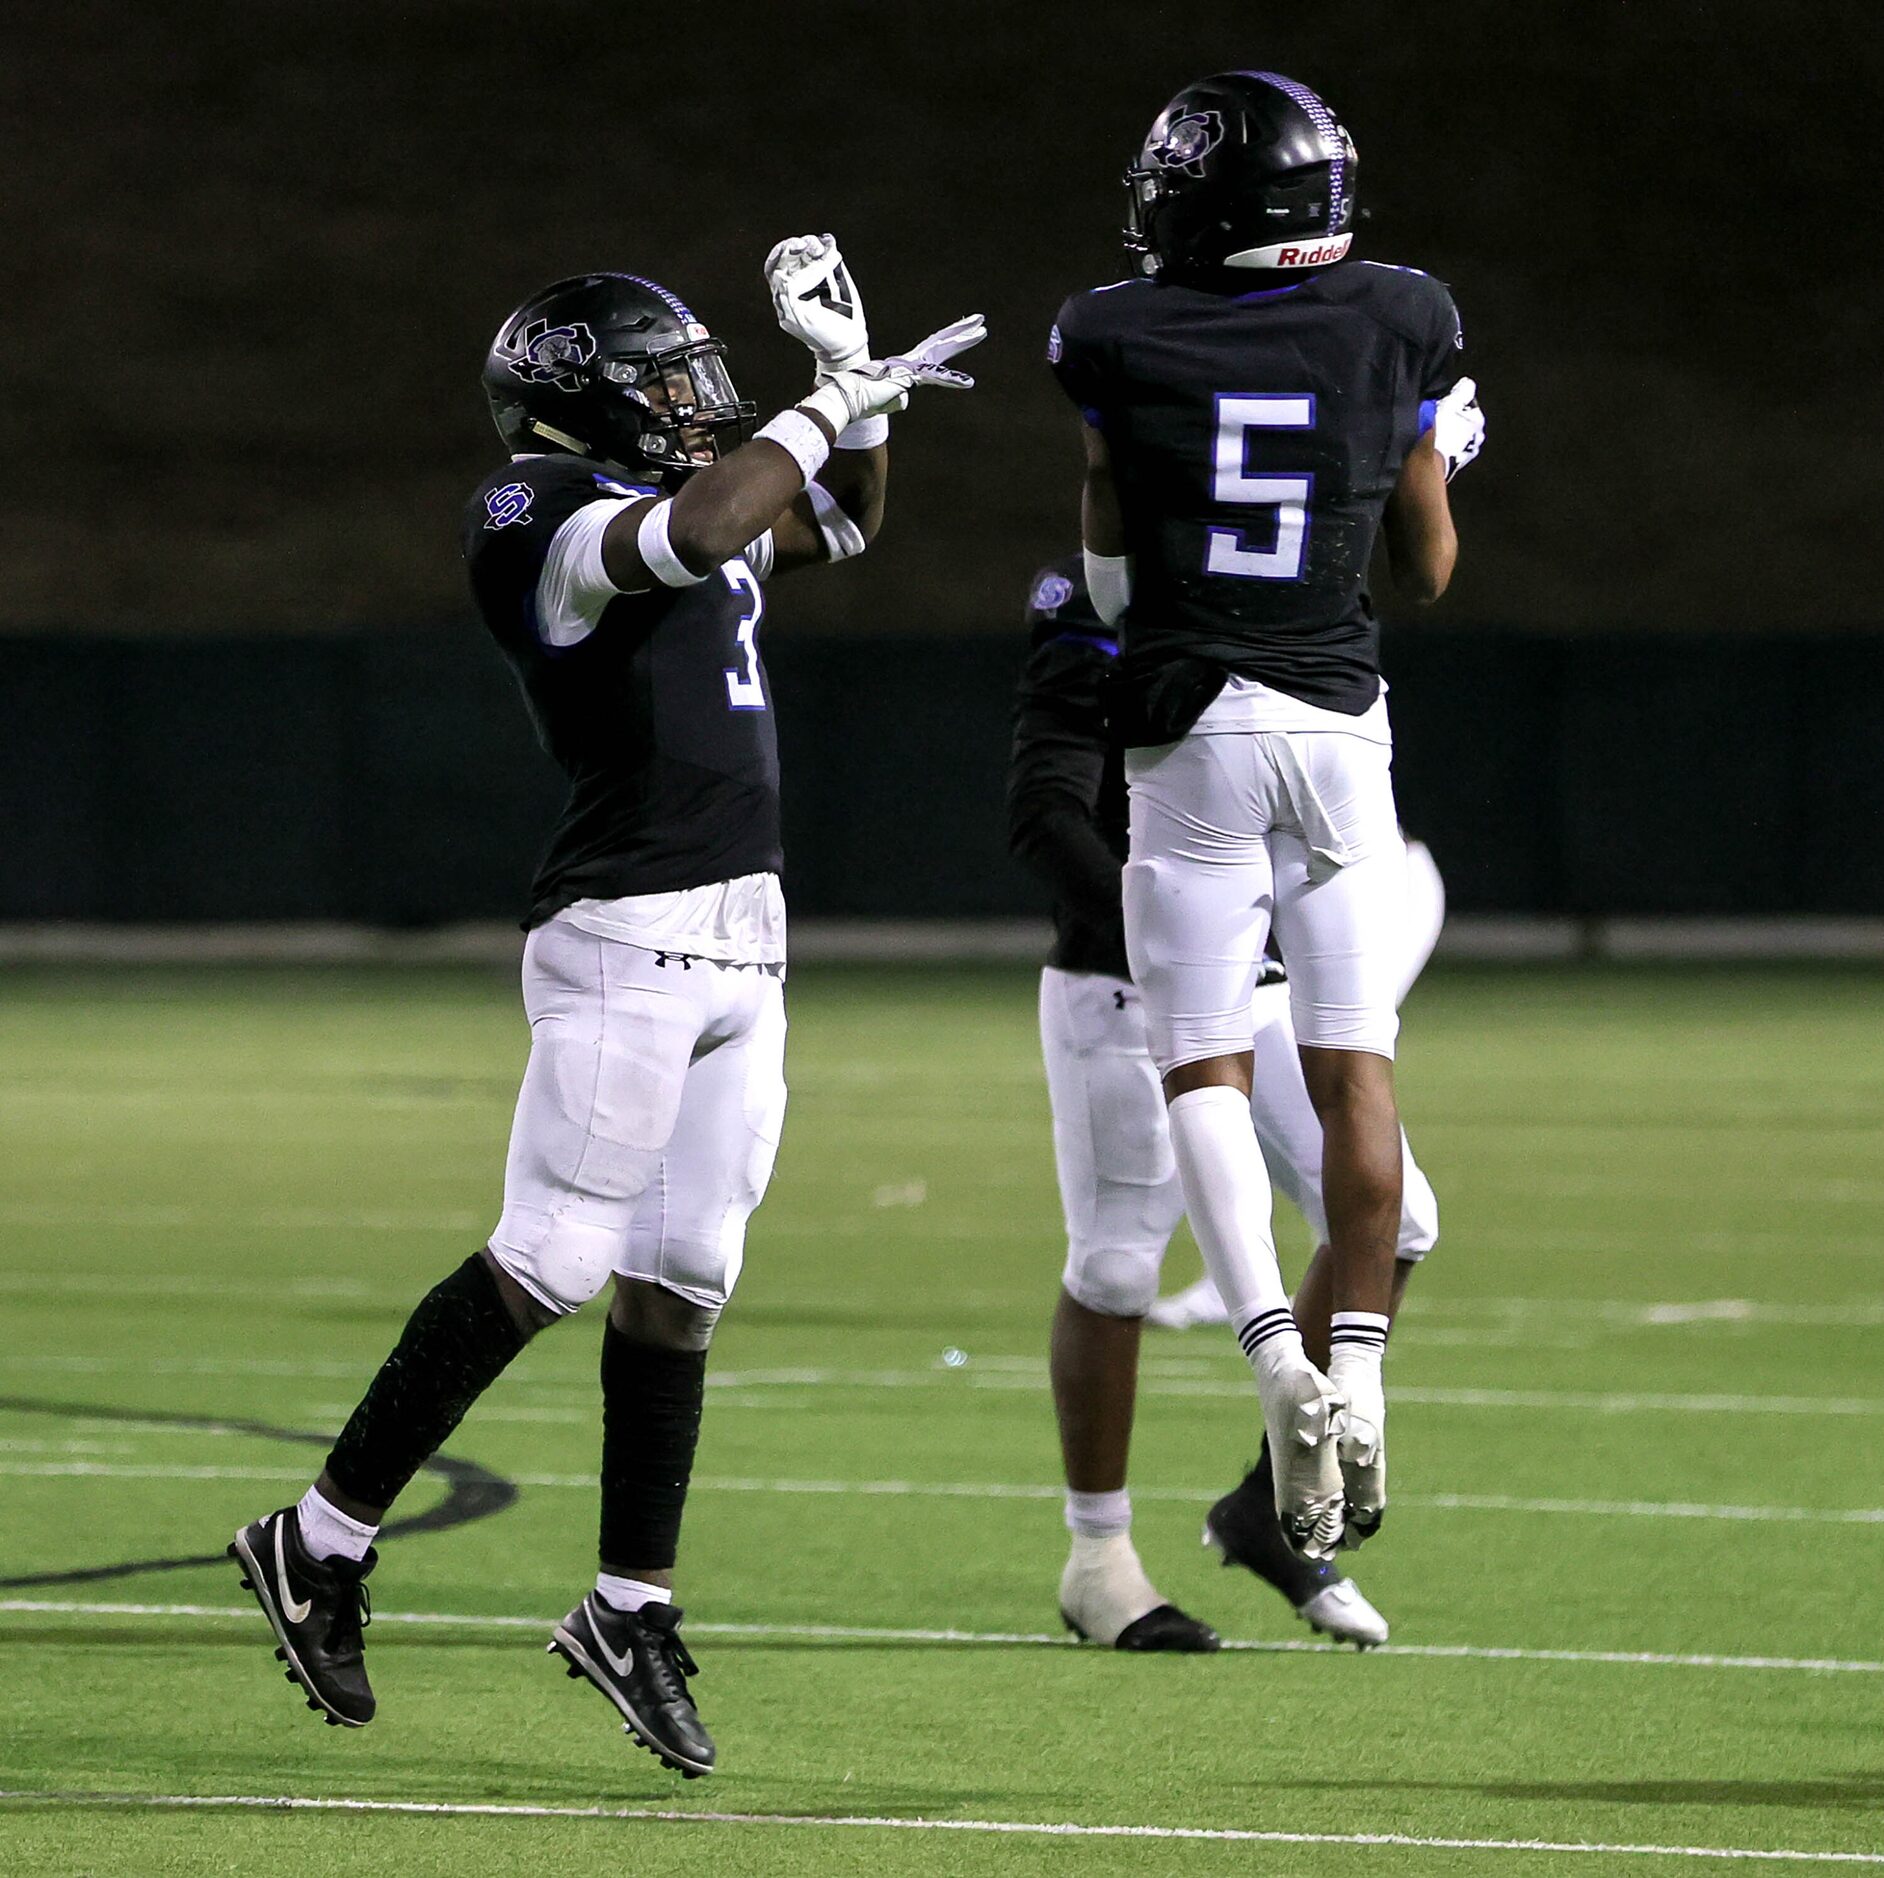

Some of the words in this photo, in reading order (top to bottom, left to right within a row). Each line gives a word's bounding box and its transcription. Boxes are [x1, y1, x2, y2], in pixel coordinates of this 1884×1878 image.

[1277, 239, 1351, 266] Riddel
[1203, 392, 1316, 581] 5
[719, 555, 767, 711] 3
